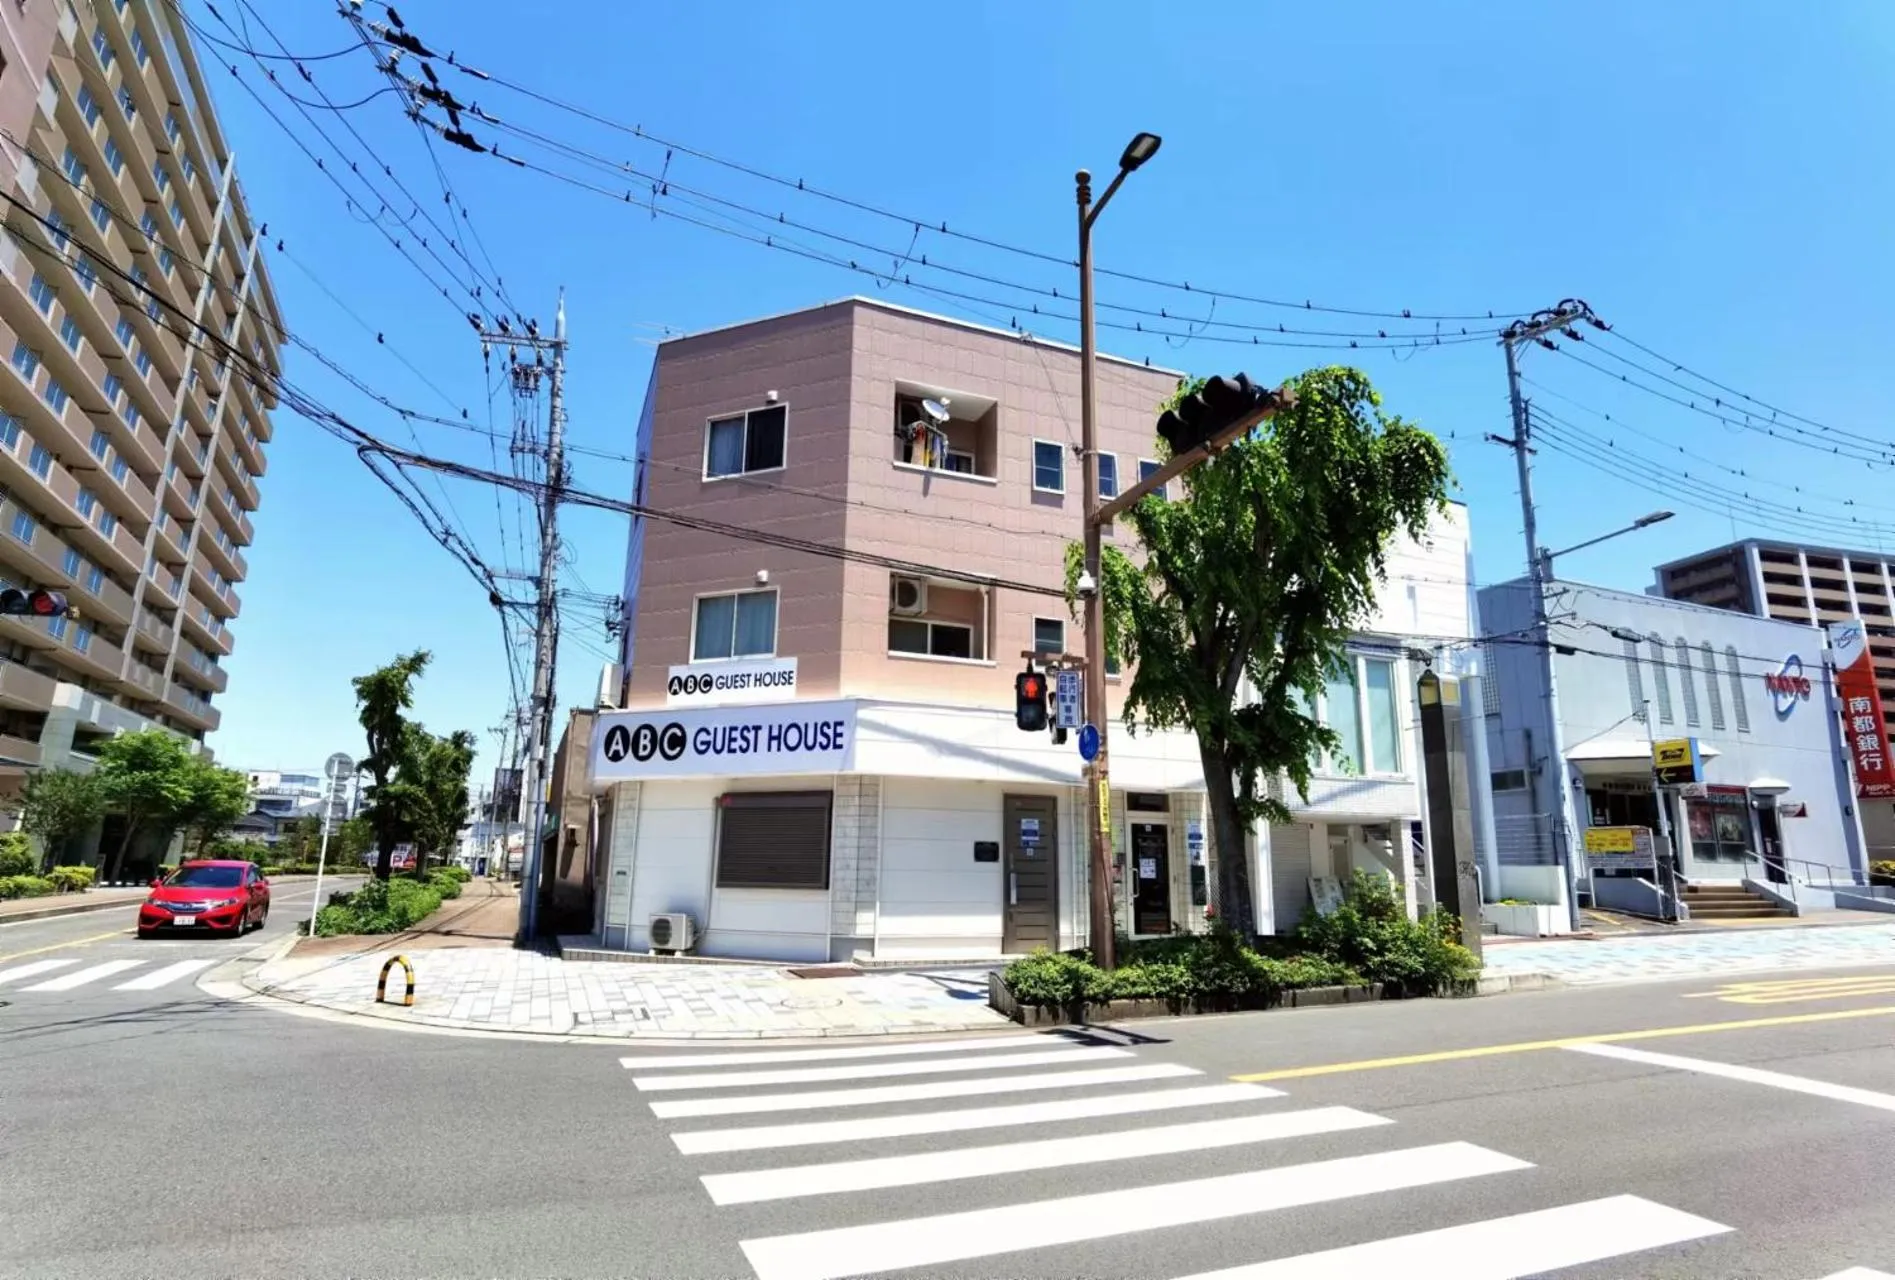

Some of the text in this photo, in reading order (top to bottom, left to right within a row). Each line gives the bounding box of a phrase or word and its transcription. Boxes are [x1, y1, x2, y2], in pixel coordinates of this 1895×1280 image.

[668, 670, 794, 695] ABC GUEST HOUSE
[604, 720, 845, 762] ABC GUEST HOUSE
[1848, 696, 1883, 771] 南都銀行
